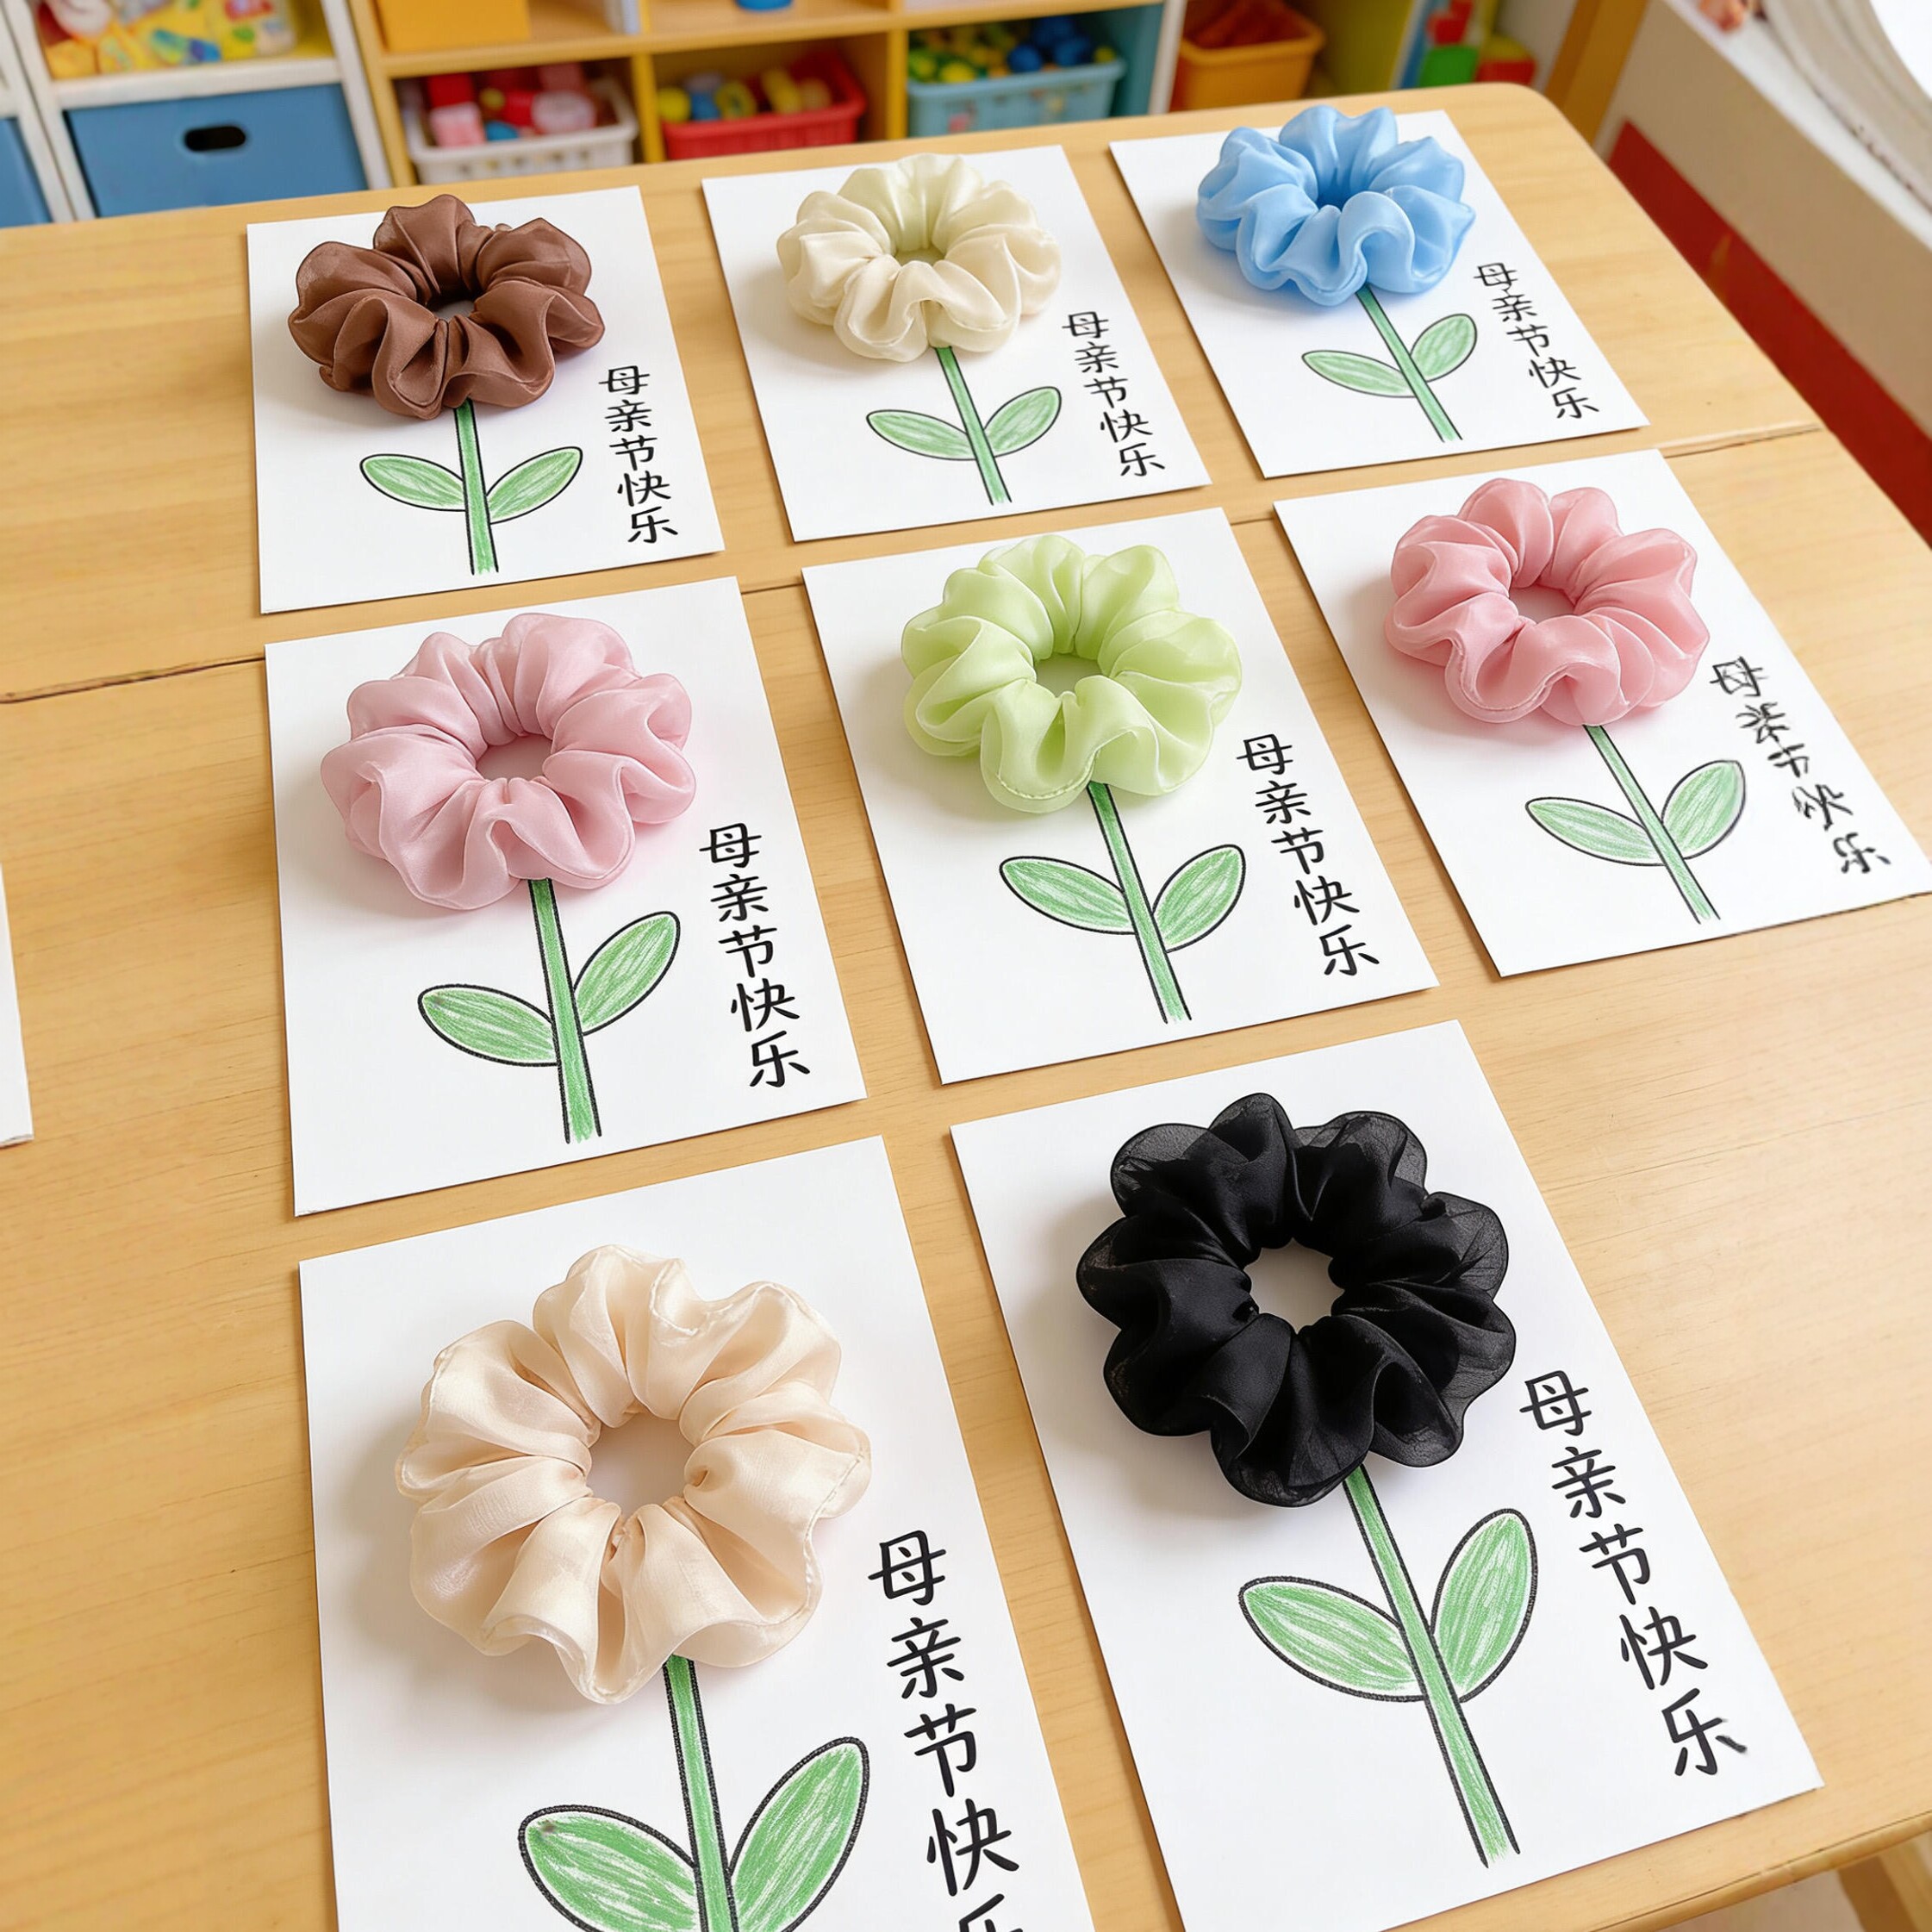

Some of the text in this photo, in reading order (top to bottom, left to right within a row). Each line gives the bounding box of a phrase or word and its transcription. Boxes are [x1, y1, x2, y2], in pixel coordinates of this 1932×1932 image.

[1062, 311, 1165, 477] 母亲节快乐
[1474, 262, 1599, 419] 母亲节快乐
[598, 365, 678, 544] 母亲节快乐
[699, 822, 811, 1088] 母亲节快乐
[1237, 733, 1380, 976] 母亲节快乐
[1520, 1370, 1748, 1777] 母亲节快乐
